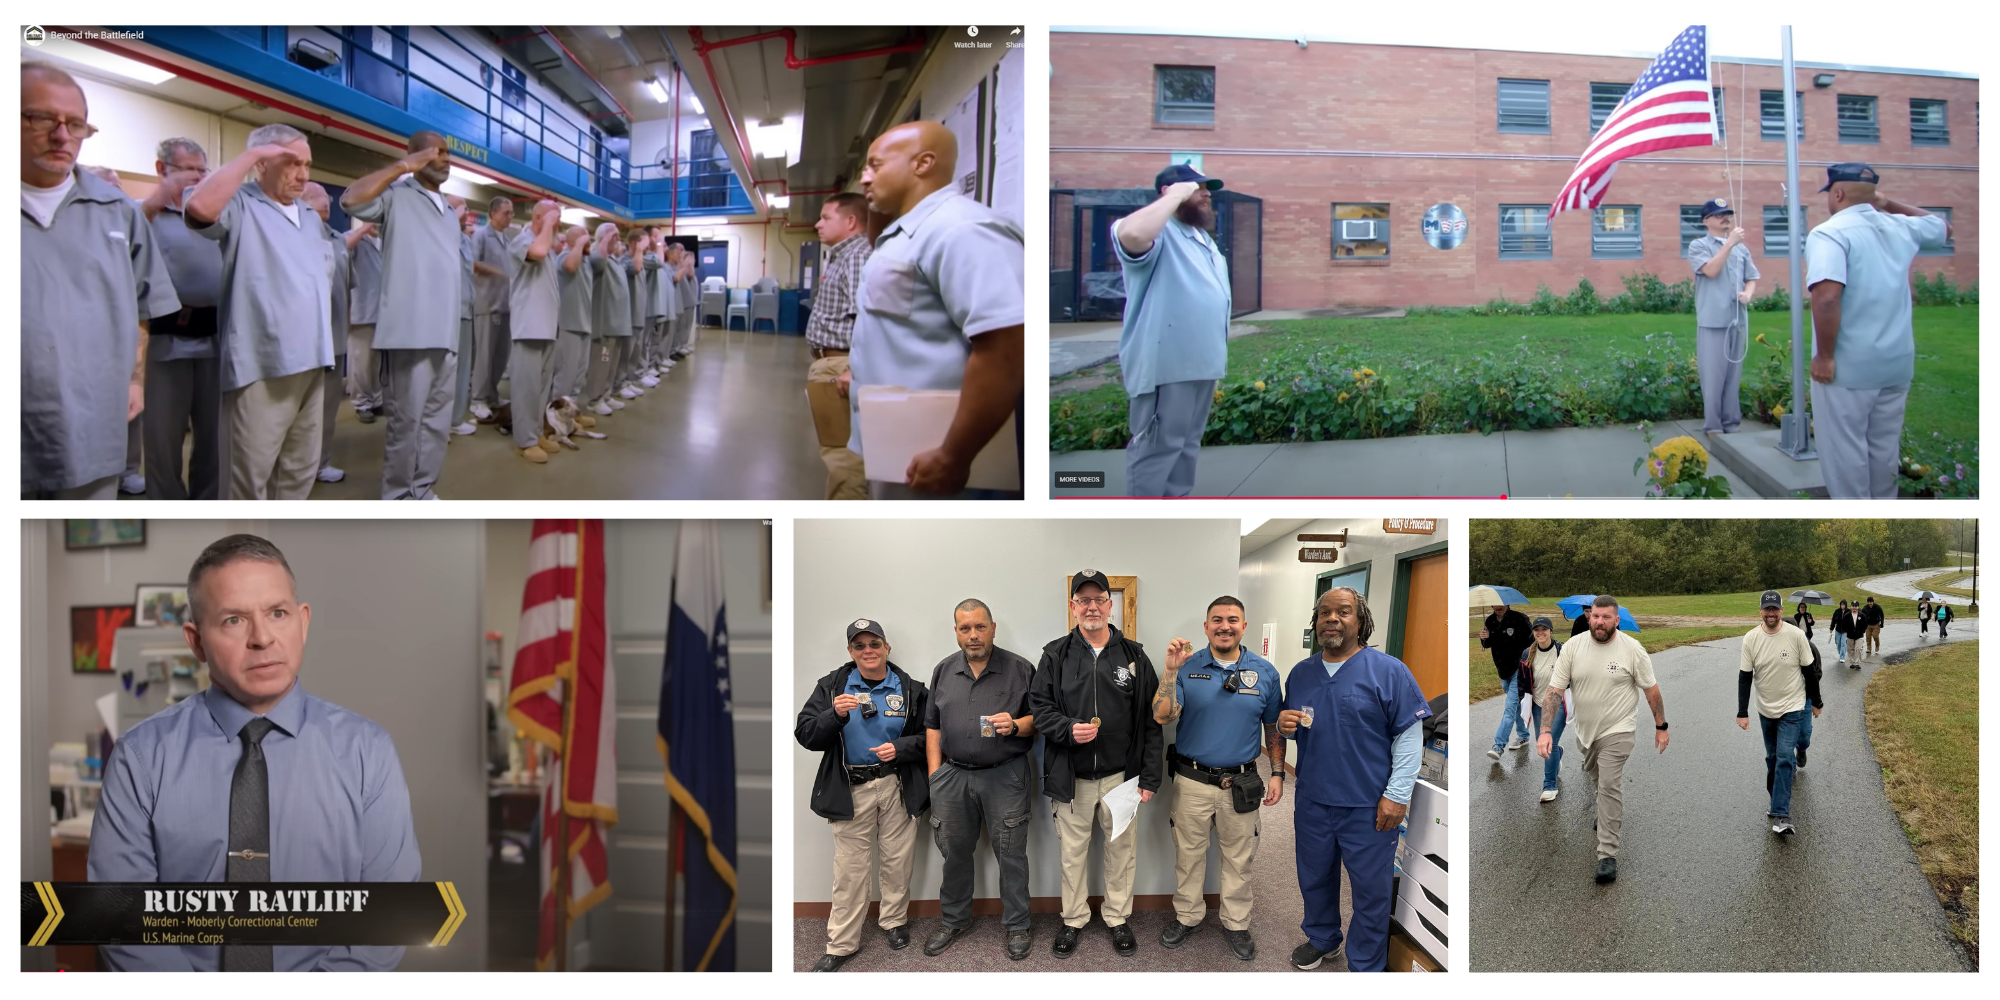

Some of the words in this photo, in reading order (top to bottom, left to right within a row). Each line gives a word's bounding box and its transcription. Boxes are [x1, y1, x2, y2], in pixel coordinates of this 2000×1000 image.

[446, 134, 488, 163] RESPECT
[1388, 518, 1404, 532] Policy
[1409, 518, 1434, 530] Procedure
